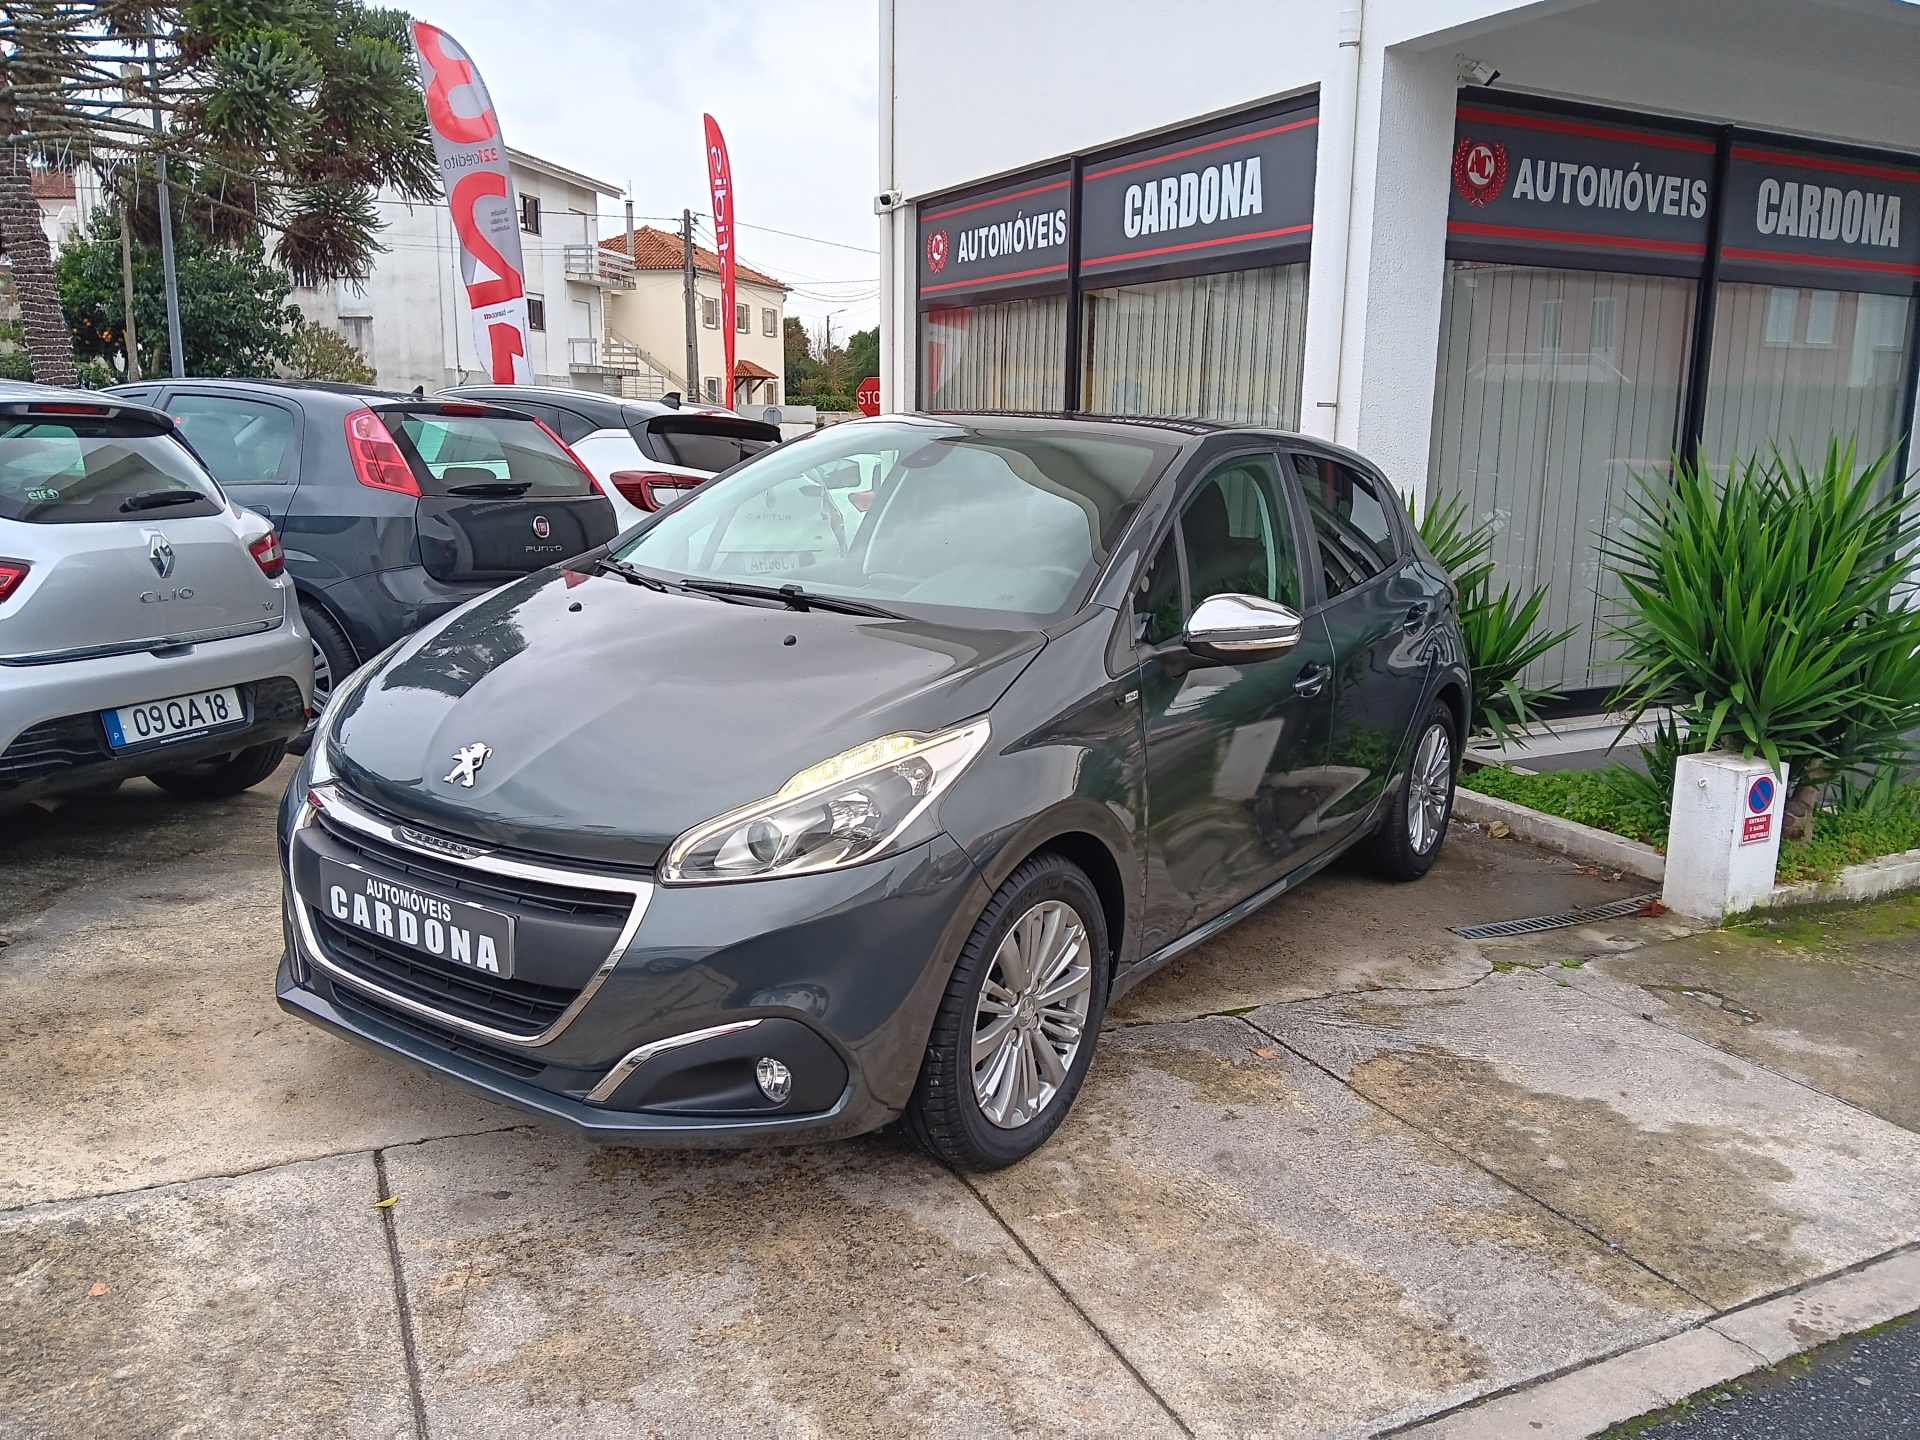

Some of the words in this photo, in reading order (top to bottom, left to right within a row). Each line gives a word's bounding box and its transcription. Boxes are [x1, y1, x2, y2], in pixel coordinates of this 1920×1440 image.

[1123, 156, 1263, 239] CARDONA
[1512, 158, 1708, 219] AUTOMÓVEIS
[1755, 178, 1901, 248] CARDONA
[957, 208, 1067, 264] AUTOMÓVEIS
[858, 391, 880, 405] STO
[139, 587, 194, 603] CLIO
[113, 732, 120, 741] P
[413, 832, 472, 854] PEUGEOT
[366, 878, 452, 922] AUTOMÓVEIS
[330, 885, 500, 973] CARDONA
